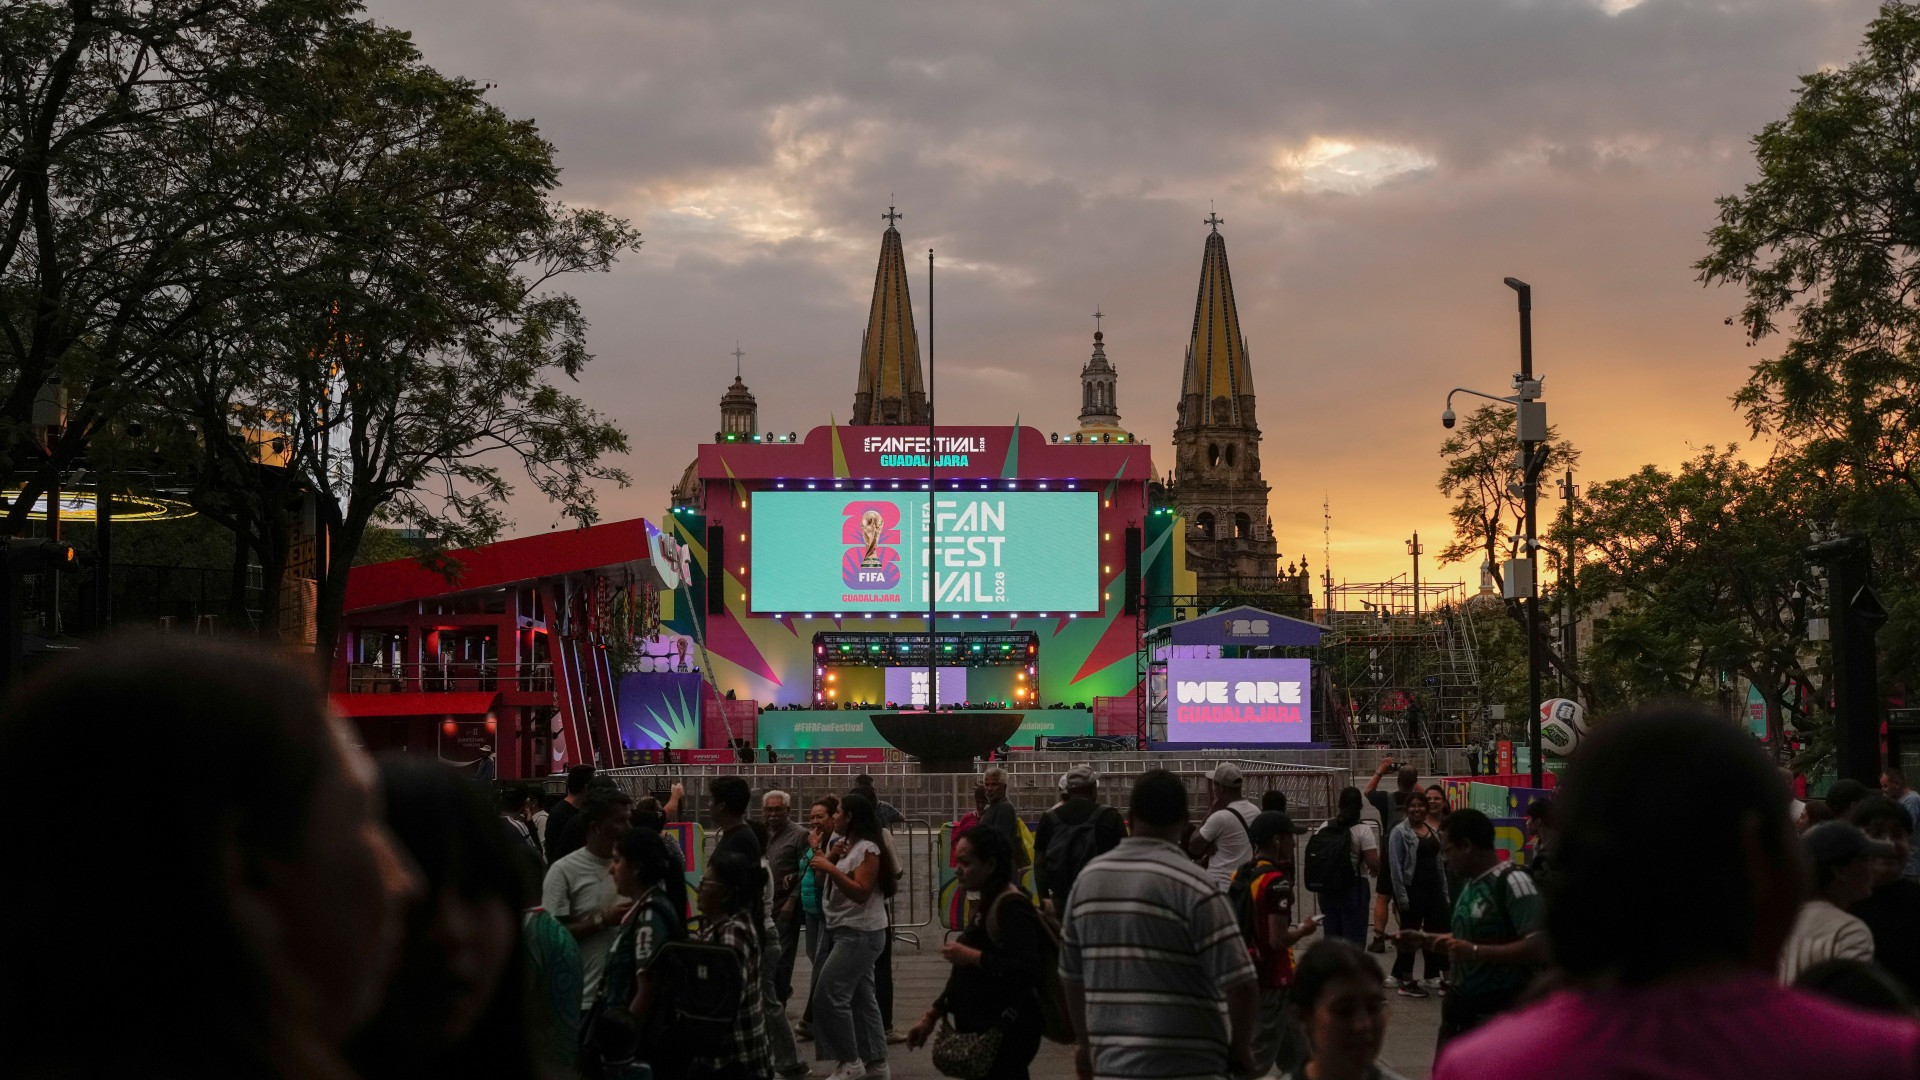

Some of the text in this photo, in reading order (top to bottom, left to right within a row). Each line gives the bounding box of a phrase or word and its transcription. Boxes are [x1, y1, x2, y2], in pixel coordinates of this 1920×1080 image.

[880, 454, 968, 466] GUADALAJARA
[922, 502, 931, 532] FIFA
[936, 501, 1004, 532] FAN
[922, 536, 1006, 566] FEST
[858, 572, 886, 582] FIFA
[995, 572, 1005, 602] 2026
[842, 594, 900, 602] GUADALAJARA
[1177, 682, 1301, 704] WE ARE
[1177, 705, 1300, 723] GUADALAJARA
[794, 722, 864, 732] #FIFAFanFestival
